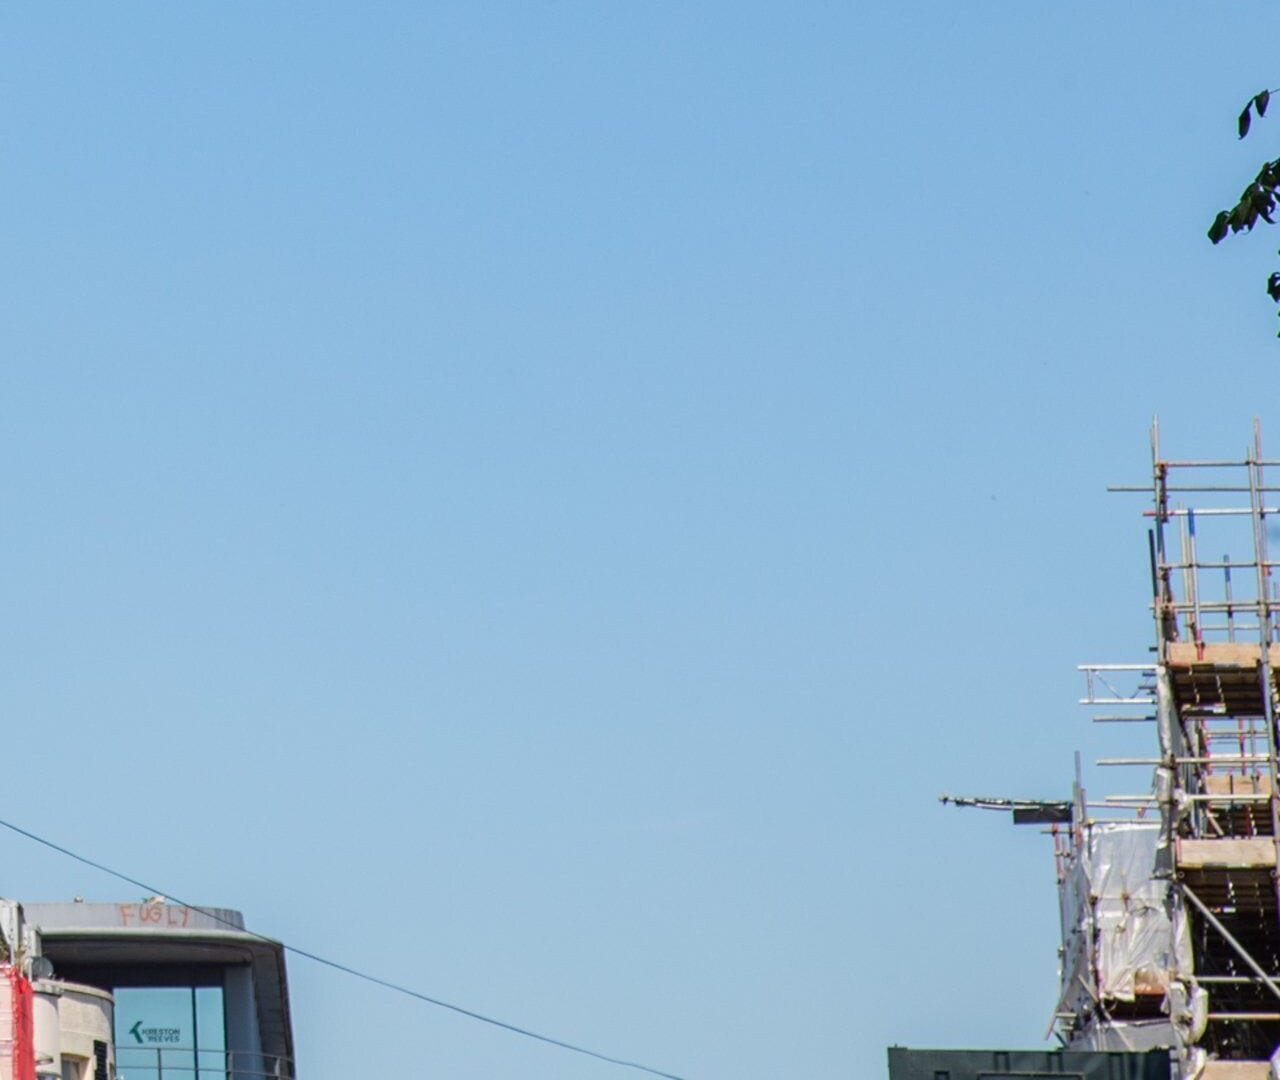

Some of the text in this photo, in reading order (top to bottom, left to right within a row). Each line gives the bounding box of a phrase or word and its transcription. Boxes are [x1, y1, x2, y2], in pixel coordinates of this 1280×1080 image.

[120, 904, 190, 927] FUGLY
[141, 1027, 181, 1036] KRESTON
[148, 1035, 180, 1043] REEVES
